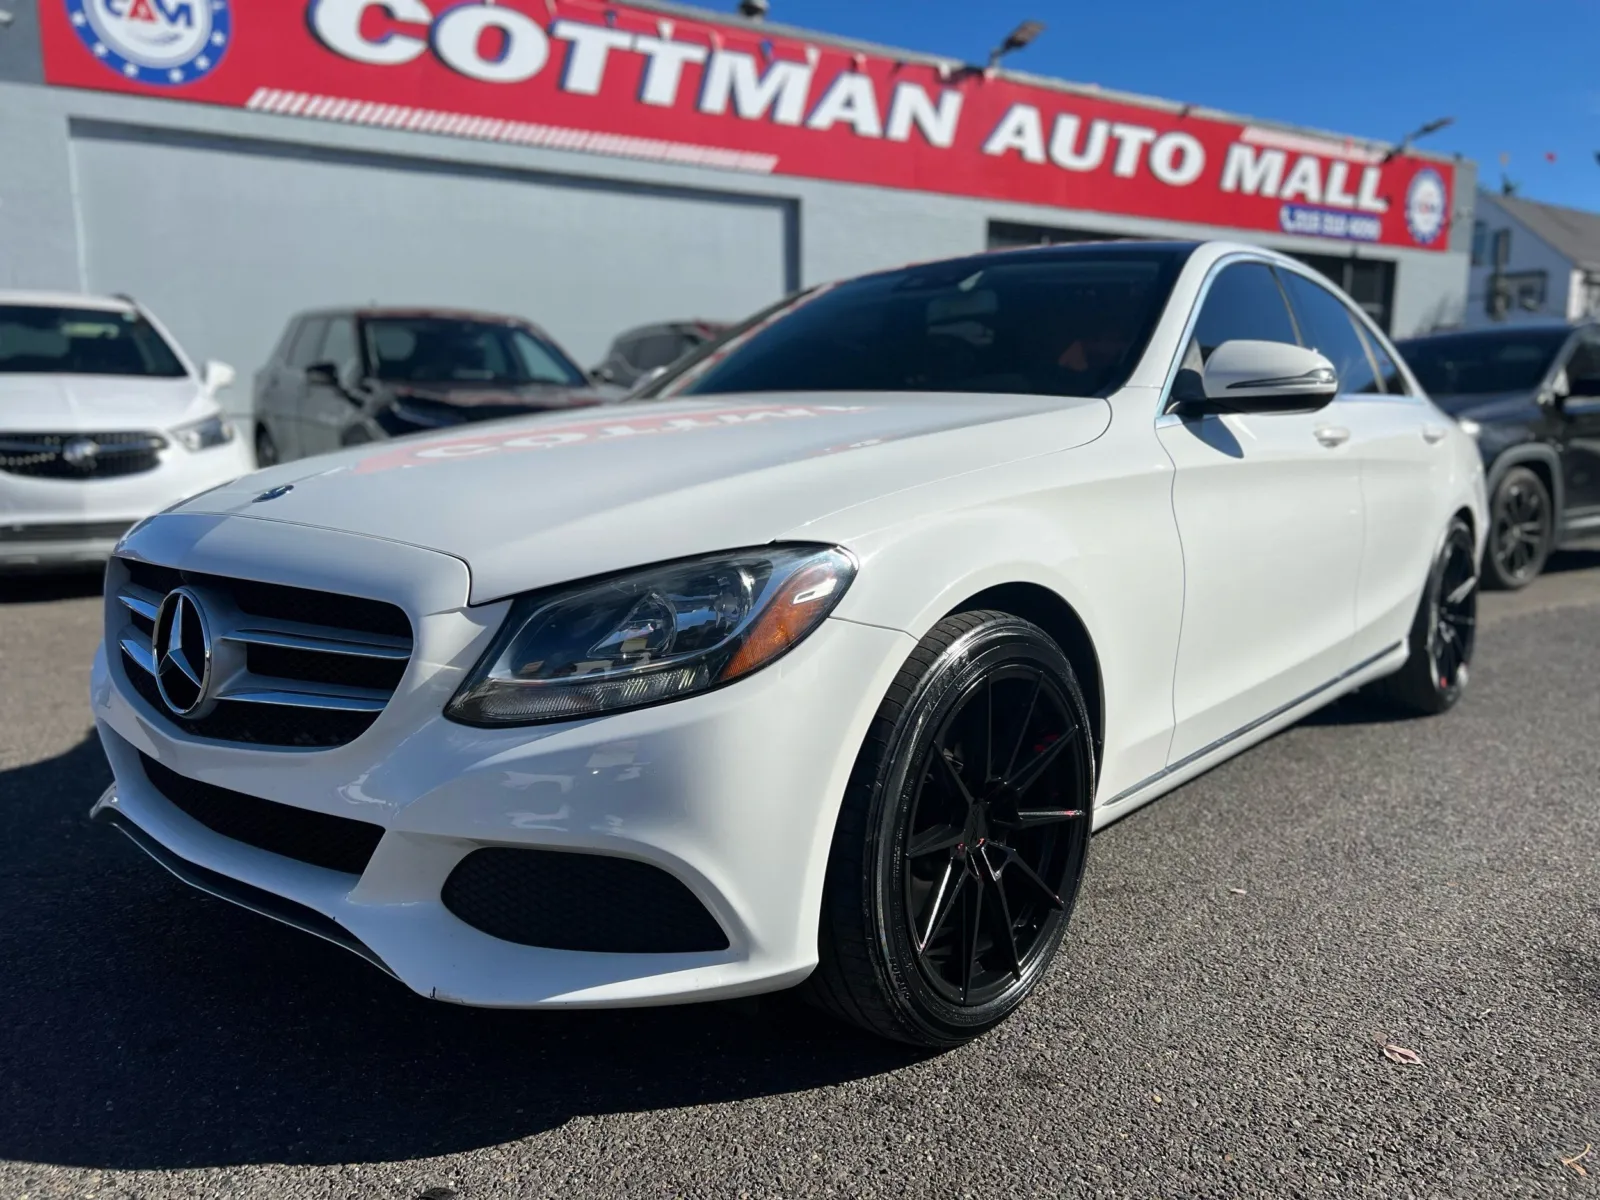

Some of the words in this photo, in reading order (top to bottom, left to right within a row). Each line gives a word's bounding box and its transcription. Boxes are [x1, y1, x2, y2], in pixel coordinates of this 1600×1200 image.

[308, 0, 963, 148] COTTMAN
[982, 102, 1206, 187] AUTO
[1220, 139, 1388, 213] MALL
